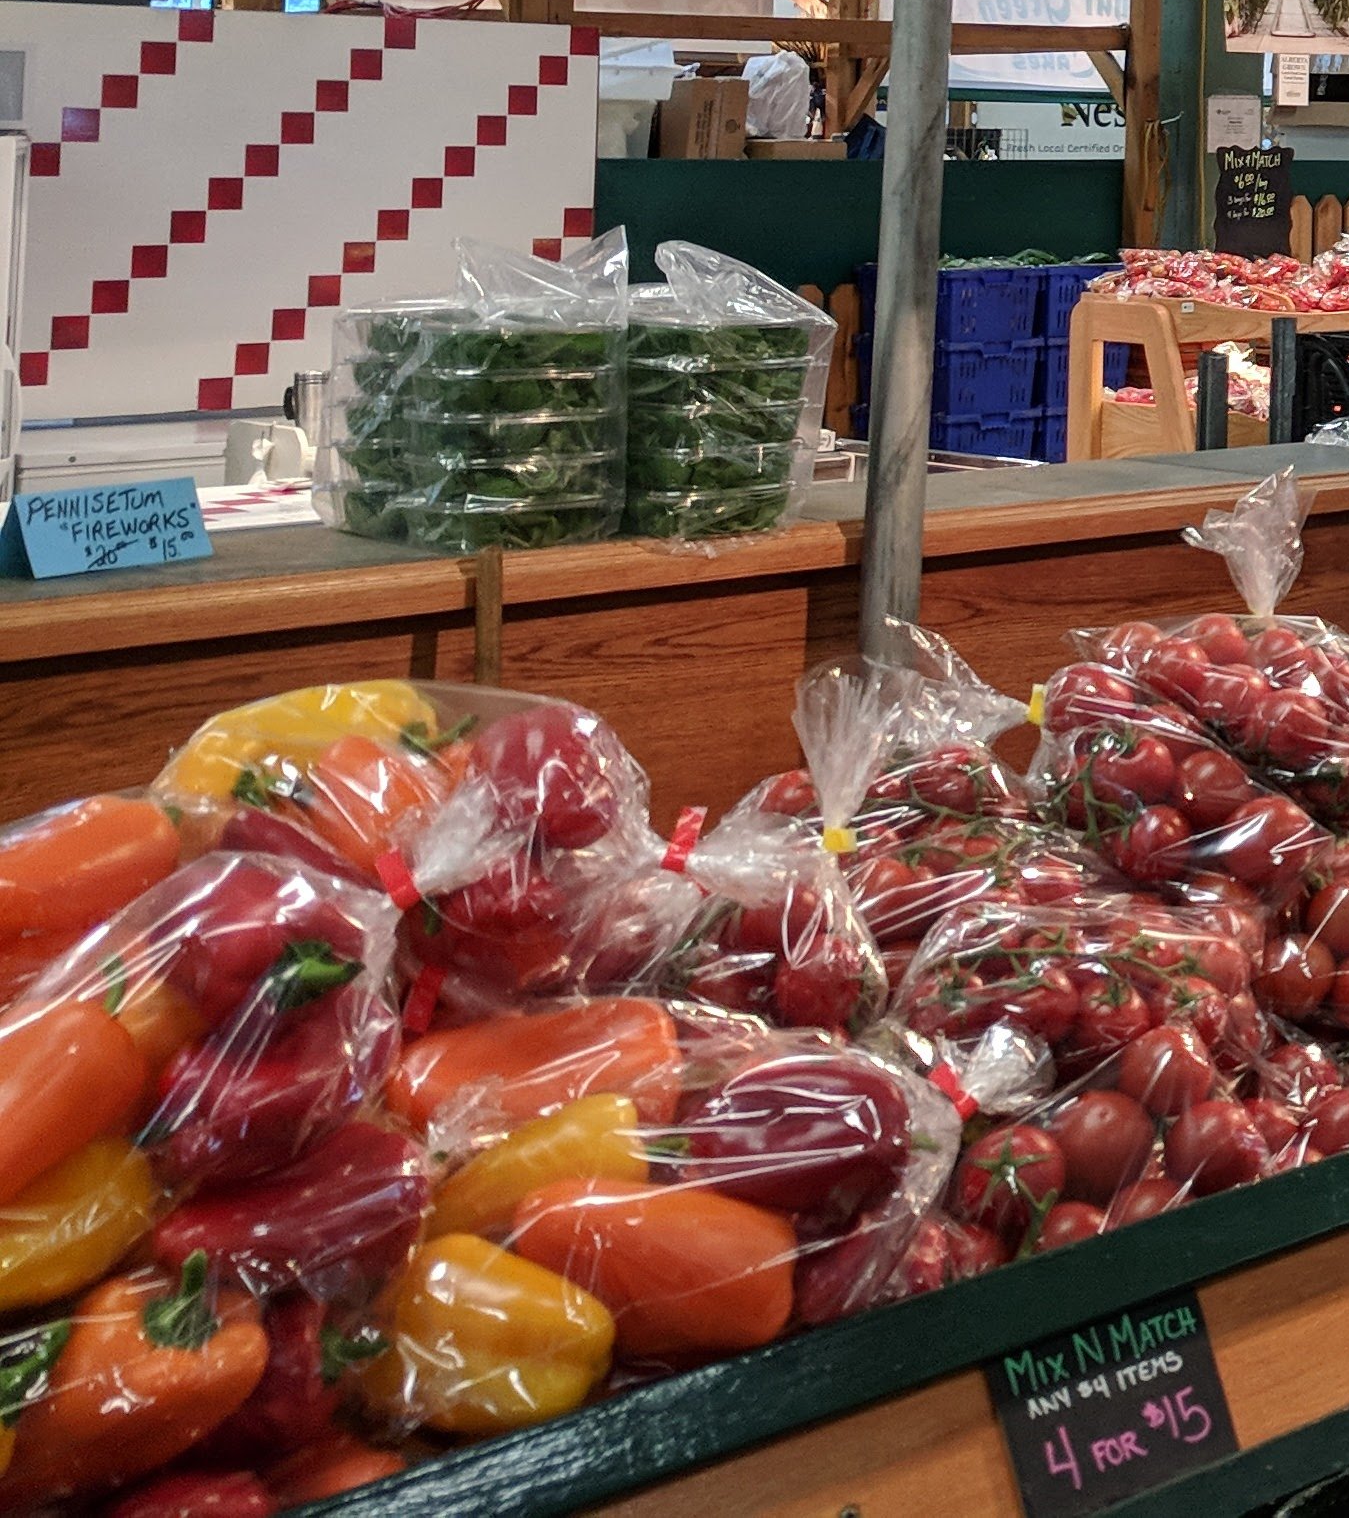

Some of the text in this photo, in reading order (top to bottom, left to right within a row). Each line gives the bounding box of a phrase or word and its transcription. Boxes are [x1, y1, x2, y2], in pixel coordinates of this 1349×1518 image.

[1038, 143, 1064, 153] Local
[1067, 143, 1110, 153] Certified
[1072, 1326, 1106, 1374] N
[1108, 1305, 1198, 1363] MATCH
[1115, 1349, 1184, 1392] ITEMS
[1043, 1384, 1213, 1491] 4 FOR $15
